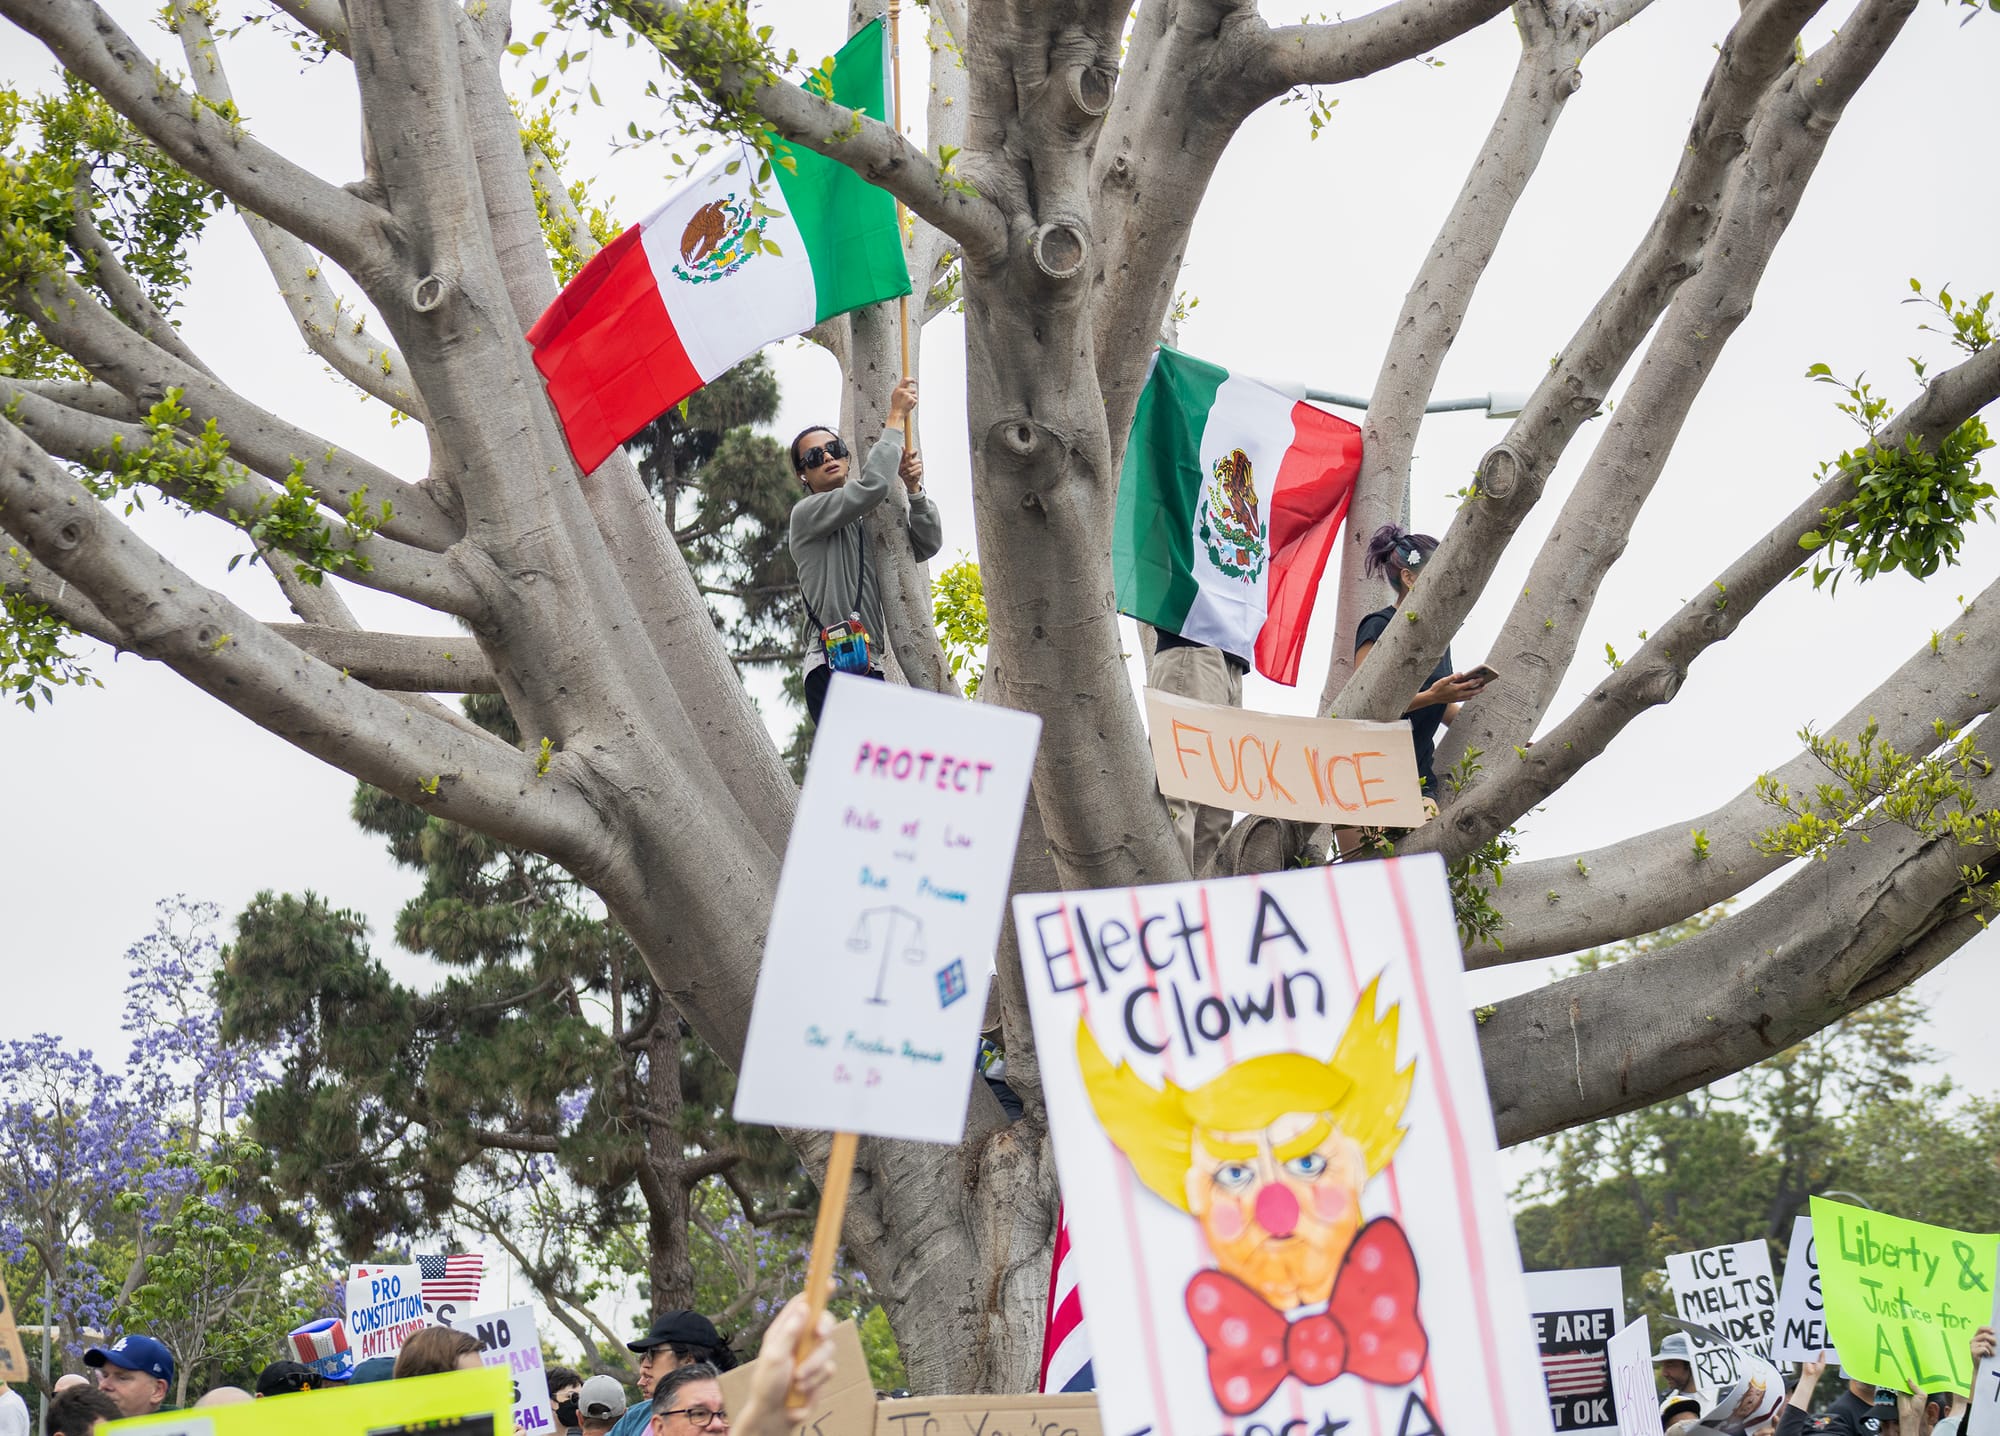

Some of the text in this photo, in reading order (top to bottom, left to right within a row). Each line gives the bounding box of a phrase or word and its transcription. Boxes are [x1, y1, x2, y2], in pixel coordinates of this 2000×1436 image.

[855, 741, 993, 793] PROTECT
[1172, 717, 1397, 812] FUCK ICE
[1034, 889, 1308, 994] Elect A
[1123, 967, 1325, 1057] Clown
[1691, 1248, 1737, 1280] ICE
[1838, 1216, 1939, 1288] Liberty
[1952, 1240, 1989, 1292] &
[371, 1275, 401, 1304] PRO
[1682, 1275, 1775, 1320] MELTS
[1859, 1277, 1971, 1330] Justice for
[351, 1293, 424, 1335] CONSTITUTION
[477, 1319, 511, 1352] NO
[1555, 1313, 1607, 1343] ARE
[1874, 1323, 1971, 1390] ALL
[1574, 1398, 1609, 1425] OK
